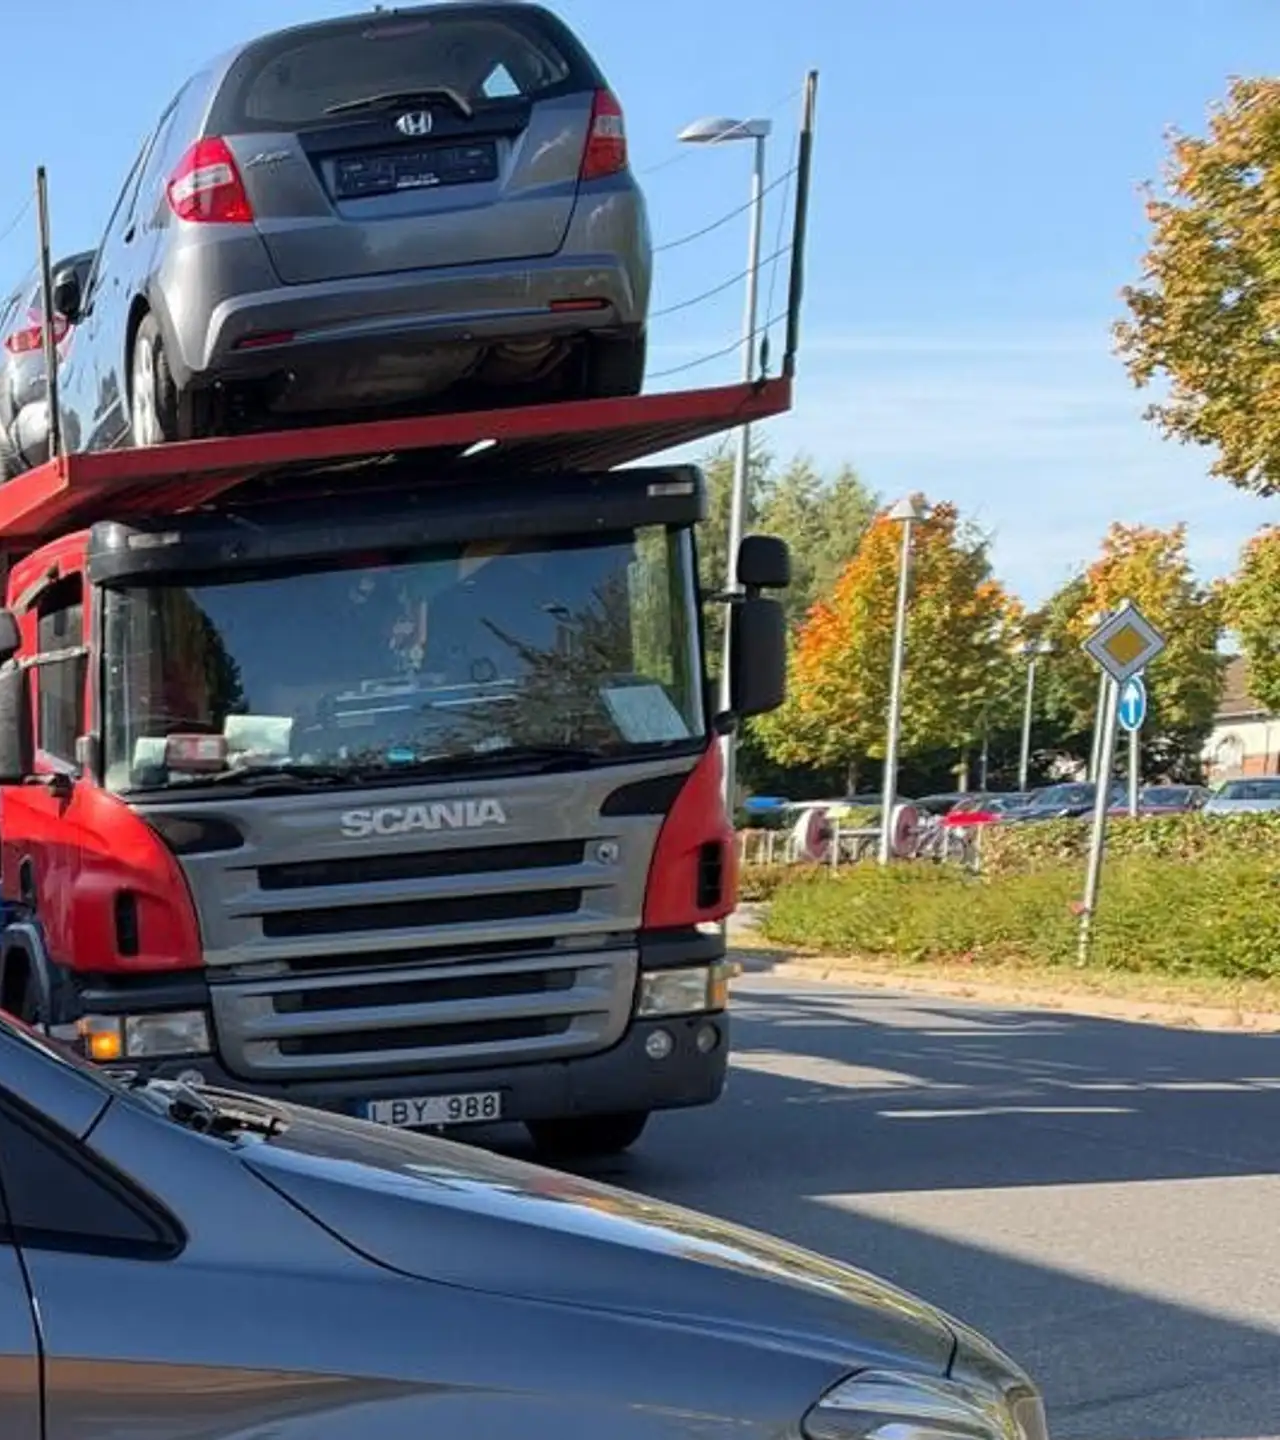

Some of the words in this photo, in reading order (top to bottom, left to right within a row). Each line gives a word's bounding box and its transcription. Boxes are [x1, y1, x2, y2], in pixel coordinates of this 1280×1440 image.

[341, 799, 507, 838] SCANIA
[371, 1101, 427, 1125] LBY
[448, 1094, 496, 1119] 988
